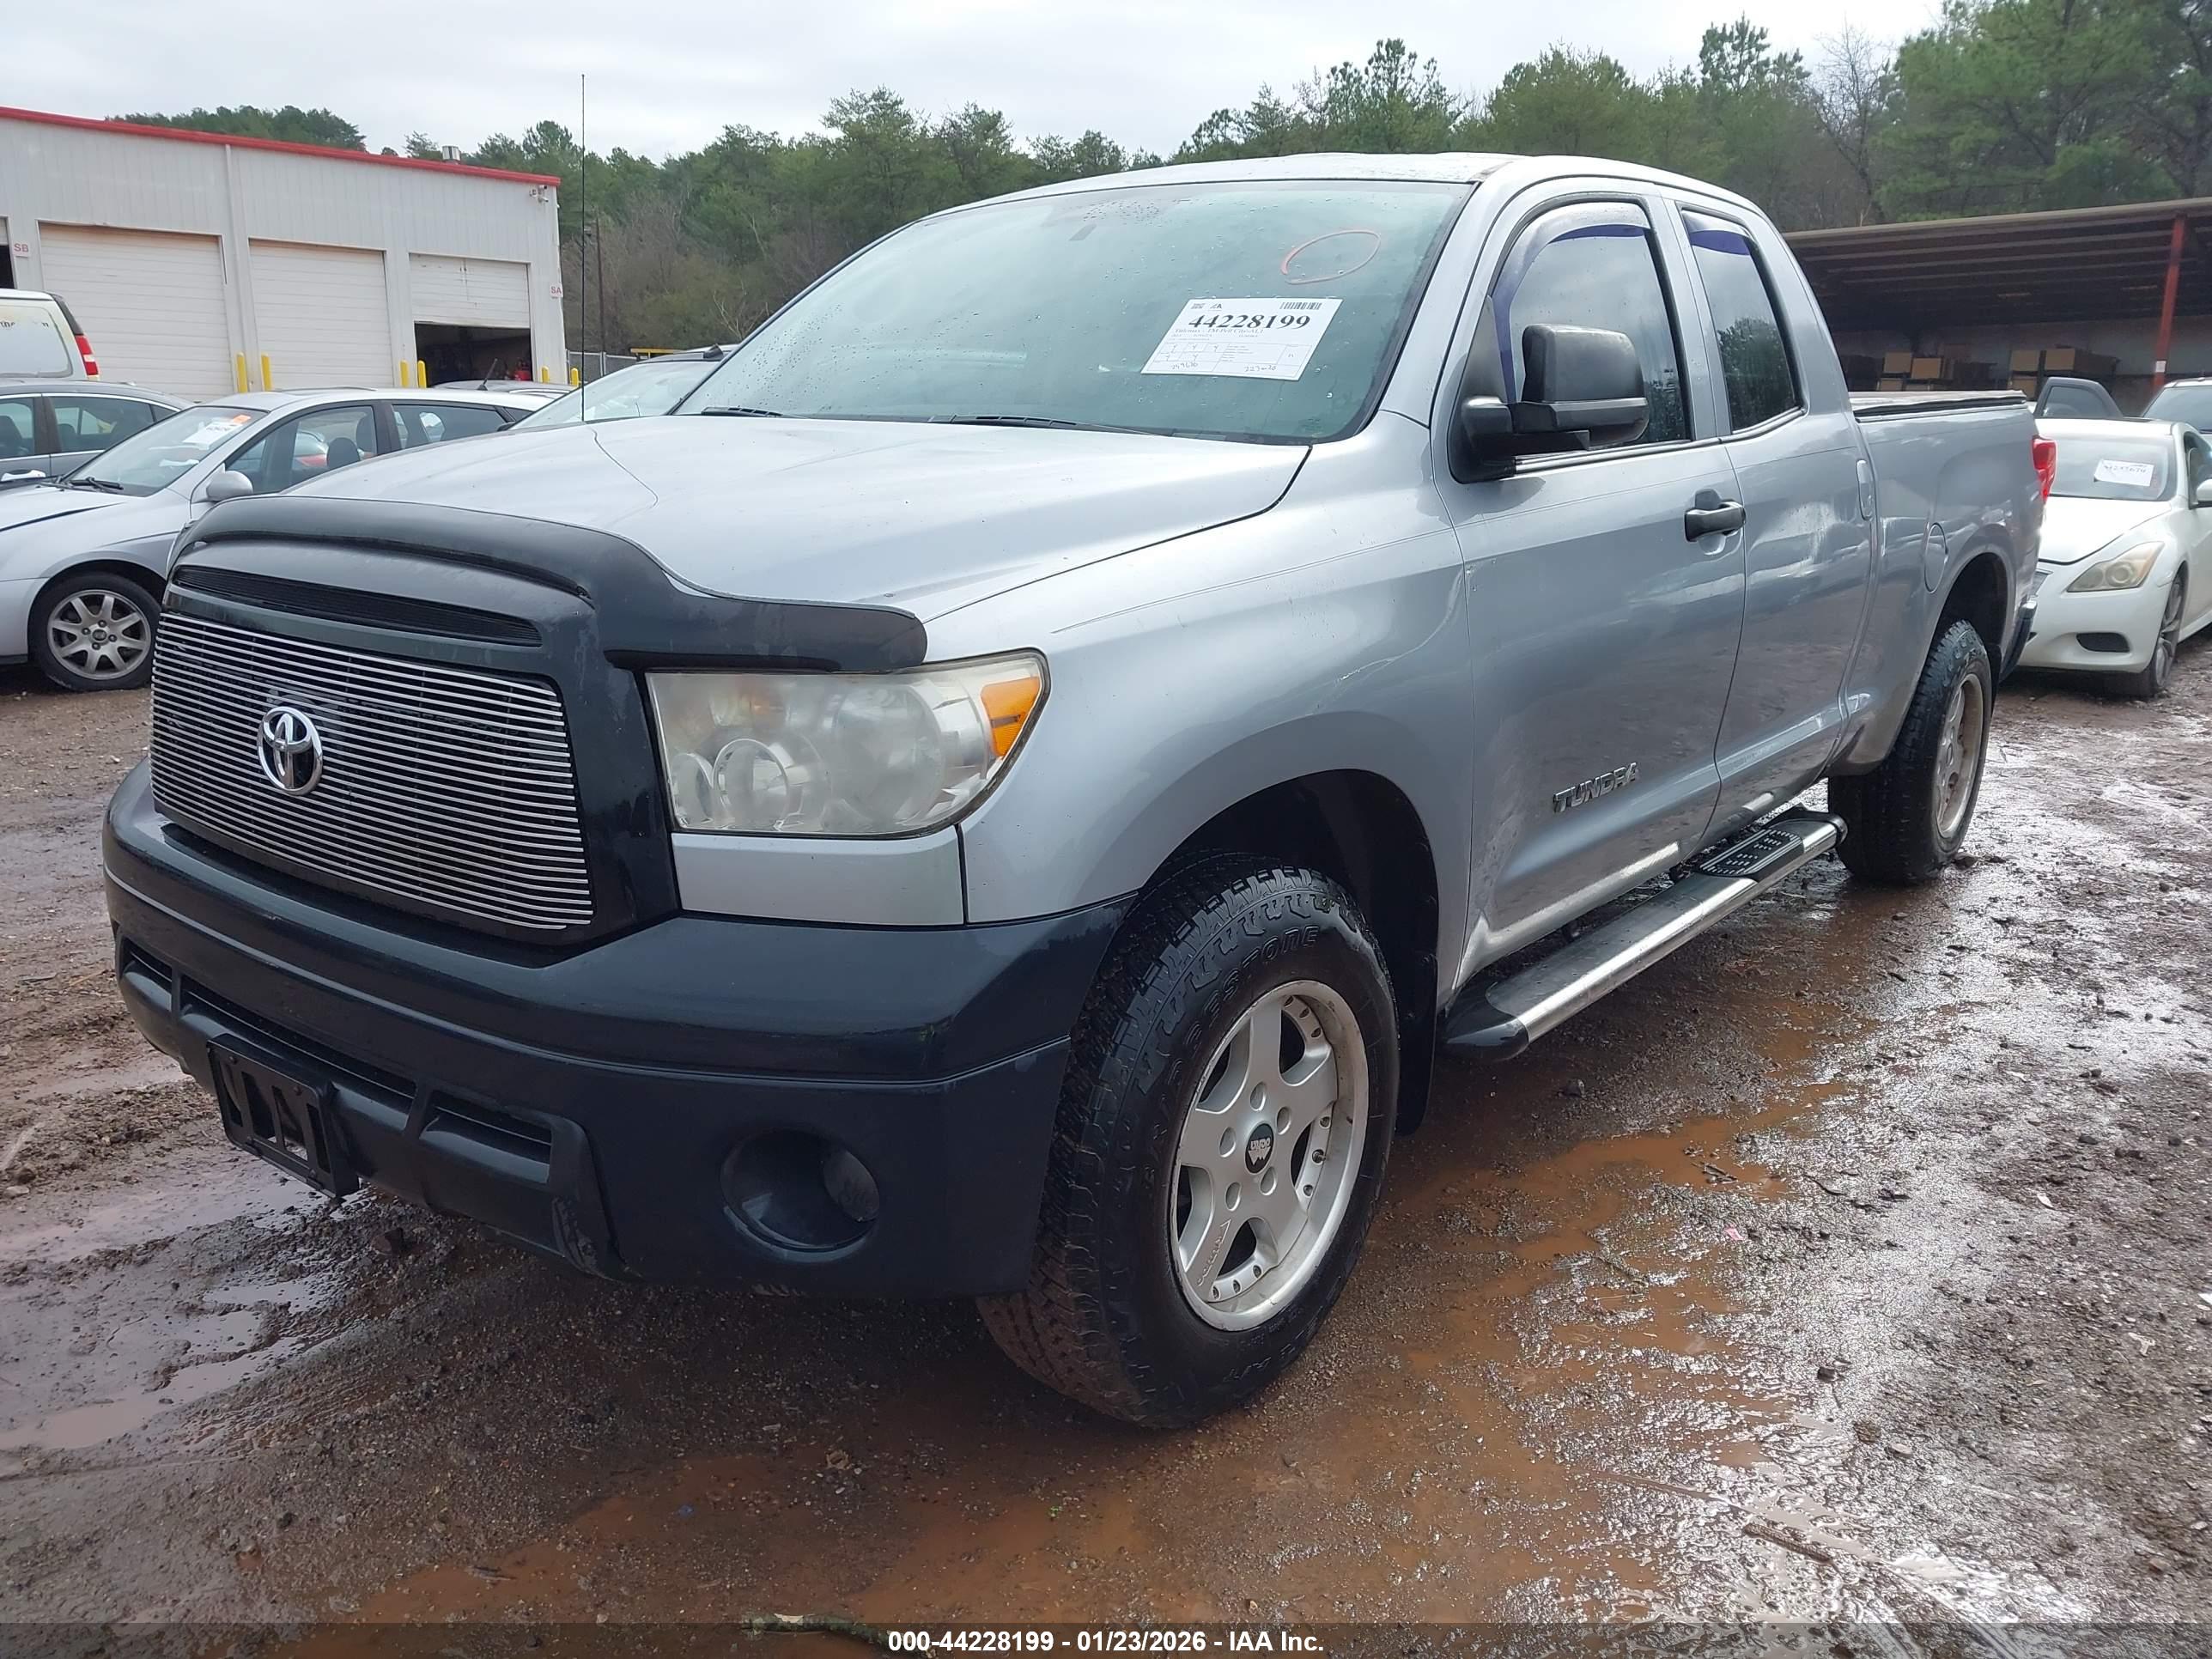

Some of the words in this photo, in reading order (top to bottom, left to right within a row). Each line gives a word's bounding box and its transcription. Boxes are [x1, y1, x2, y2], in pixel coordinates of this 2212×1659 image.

[14, 243, 29, 252] SB
[550, 286, 562, 295] SA
[1188, 314, 1311, 330] 44228199
[1553, 761, 1638, 813] TUNDRA
